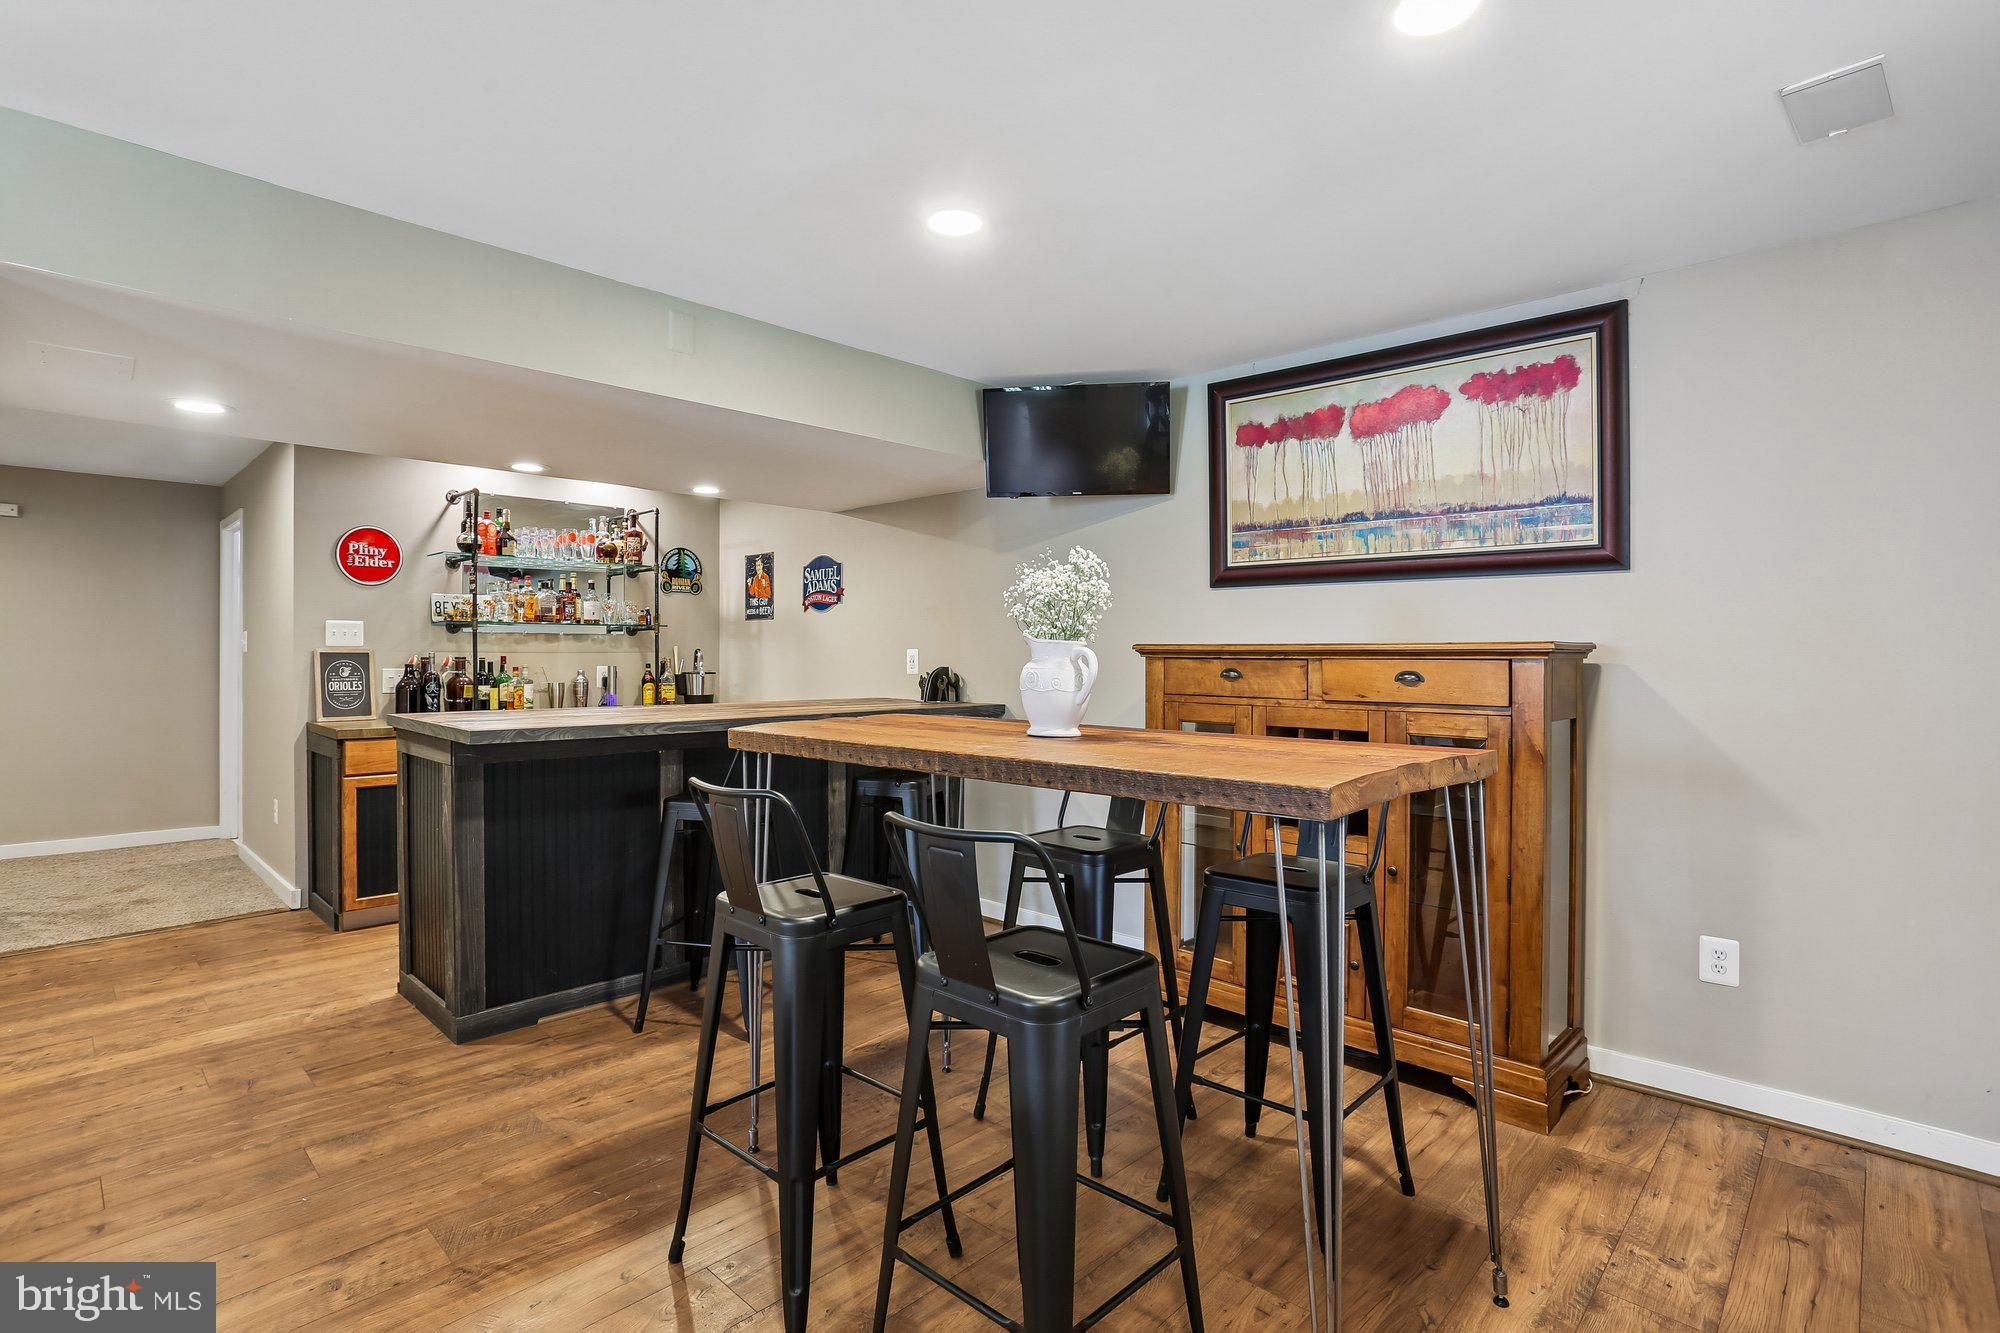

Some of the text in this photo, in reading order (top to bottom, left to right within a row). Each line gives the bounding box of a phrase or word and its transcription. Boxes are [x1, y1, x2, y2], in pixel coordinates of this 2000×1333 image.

[348, 541, 387, 558] Pliny
[354, 554, 395, 568] Elder
[804, 565, 840, 583] SAMUEL
[806, 580, 837, 596] ADAMS
[328, 681, 363, 691] ORIOLES
